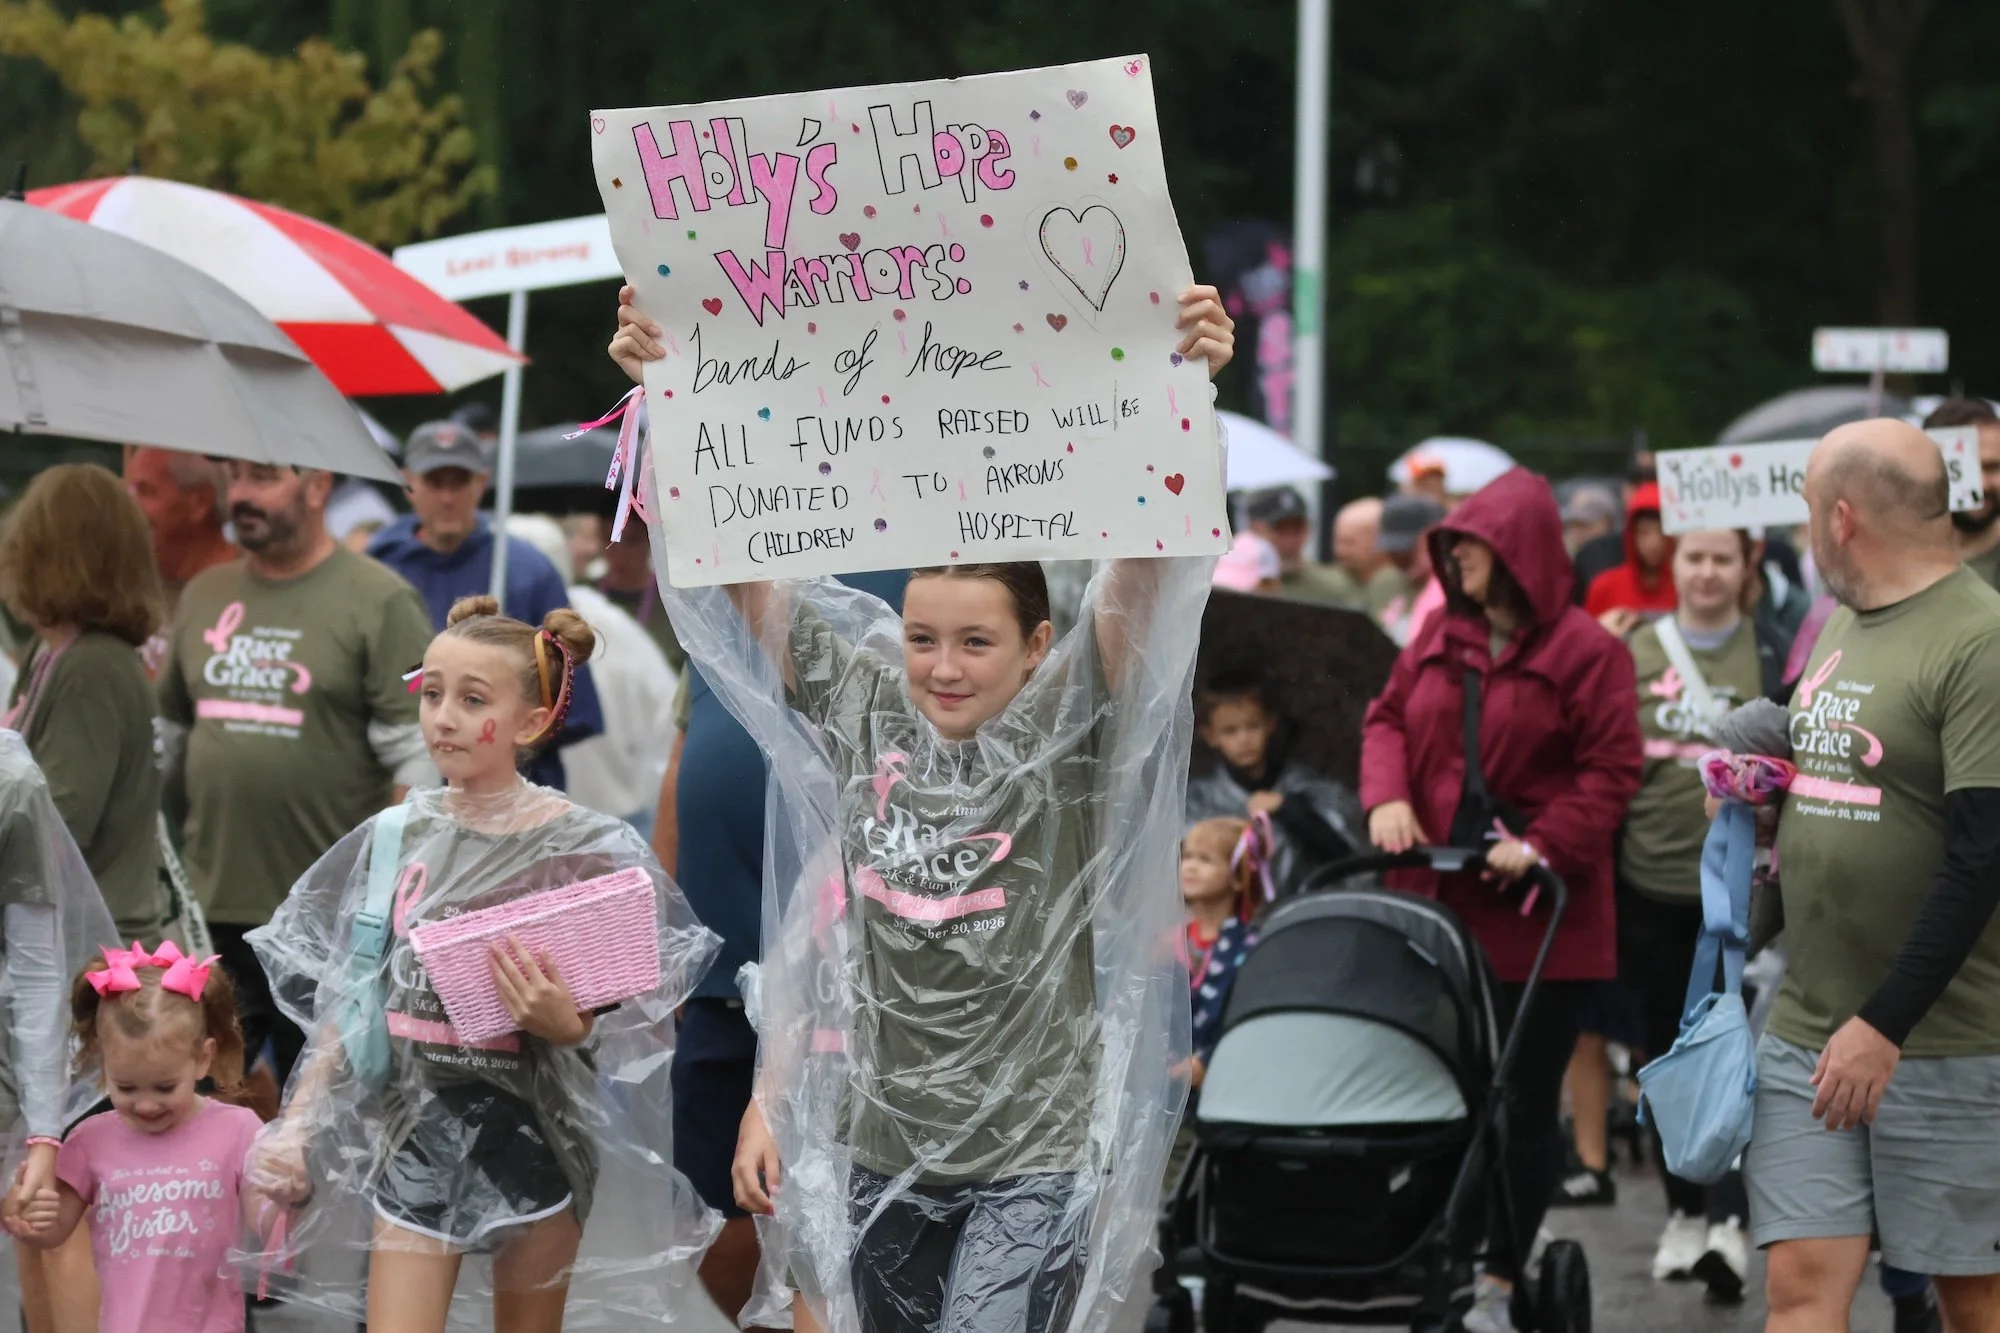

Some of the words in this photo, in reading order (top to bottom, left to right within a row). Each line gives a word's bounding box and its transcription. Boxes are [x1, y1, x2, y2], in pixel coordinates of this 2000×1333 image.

[632, 117, 838, 250] Holly's
[868, 100, 1015, 203] Hope
[506, 242, 591, 268] Strong
[689, 322, 810, 394] bands
[834, 327, 880, 396] of
[905, 321, 1012, 379] hope
[695, 422, 755, 475] ALL
[790, 415, 904, 462] FUNDS
[938, 408, 1030, 439] RAISED
[1051, 403, 1109, 429] WILL
[1121, 398, 1140, 418] BE
[709, 484, 849, 527] DONATED
[902, 472, 948, 499] TO
[986, 458, 1064, 496] AKRONS
[1768, 463, 1804, 496] Ho
[748, 527, 854, 563] CHILDREN
[958, 511, 1079, 543] HOSPITAL
[203, 653, 288, 689] Grace
[226, 636, 293, 667] Race
[1806, 690, 1861, 729] Race
[1790, 711, 1852, 758] Grace
[1796, 801, 1836, 816] September
[880, 867, 902, 882] 5K
[905, 872, 915, 885] &
[920, 877, 944, 891] Fun
[893, 917, 948, 940] Sepber
[951, 922, 970, 935] 20,
[973, 917, 1006, 933] 2026
[471, 1056, 487, 1068] 20,
[96, 1179, 225, 1223] Awesome
[109, 1206, 199, 1257] Sister
